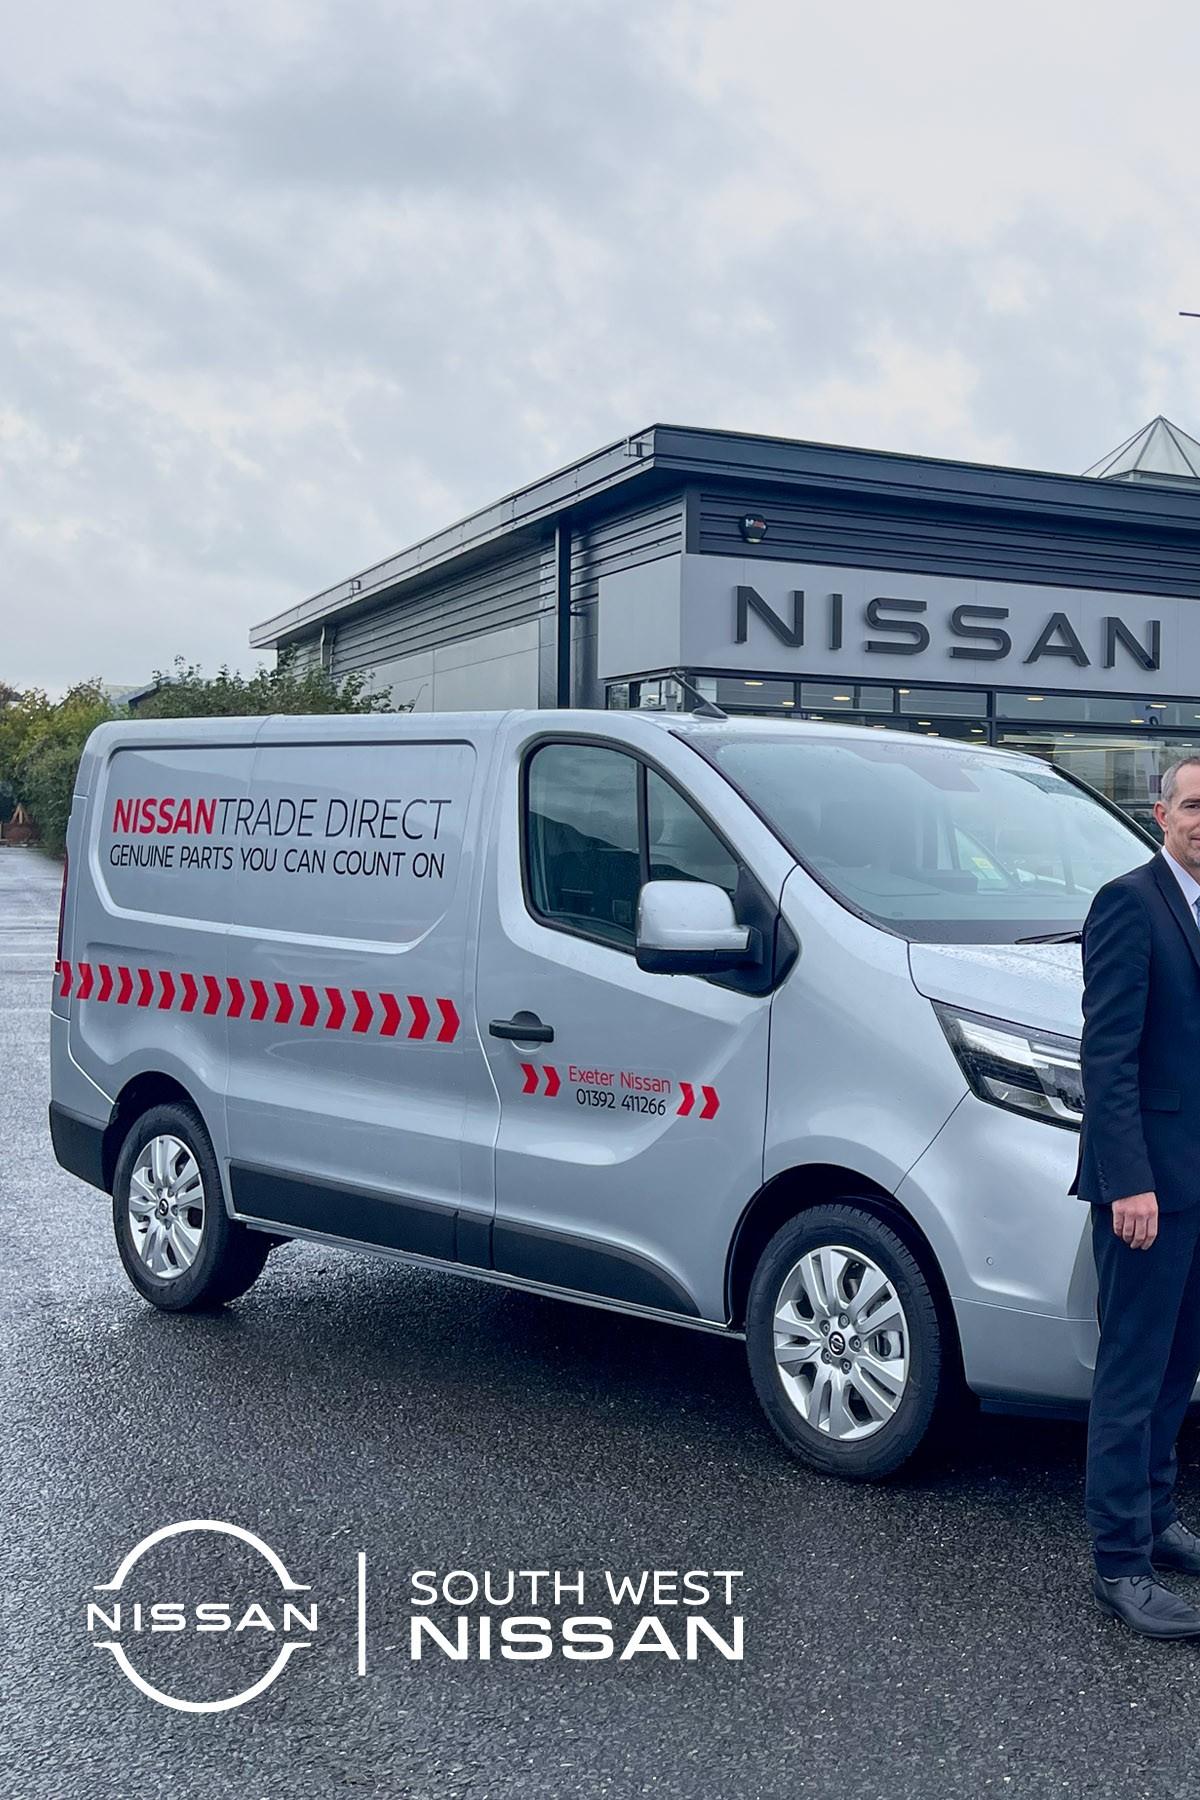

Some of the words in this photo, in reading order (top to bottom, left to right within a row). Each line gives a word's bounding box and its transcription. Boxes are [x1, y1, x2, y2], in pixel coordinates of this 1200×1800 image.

[733, 585, 1161, 671] NISSAN
[325, 799, 452, 841] DIRECT
[110, 844, 175, 868] GENUINE
[179, 846, 234, 871] PARTS
[240, 847, 277, 872] YOU
[283, 849, 327, 874] CAN
[333, 850, 405, 877] COUNT
[412, 852, 446, 879] ON
[568, 1065, 615, 1087] Exeter
[620, 1072, 672, 1094] Nissan
[576, 1088, 616, 1109] 01392
[621, 1094, 667, 1117] 411266
